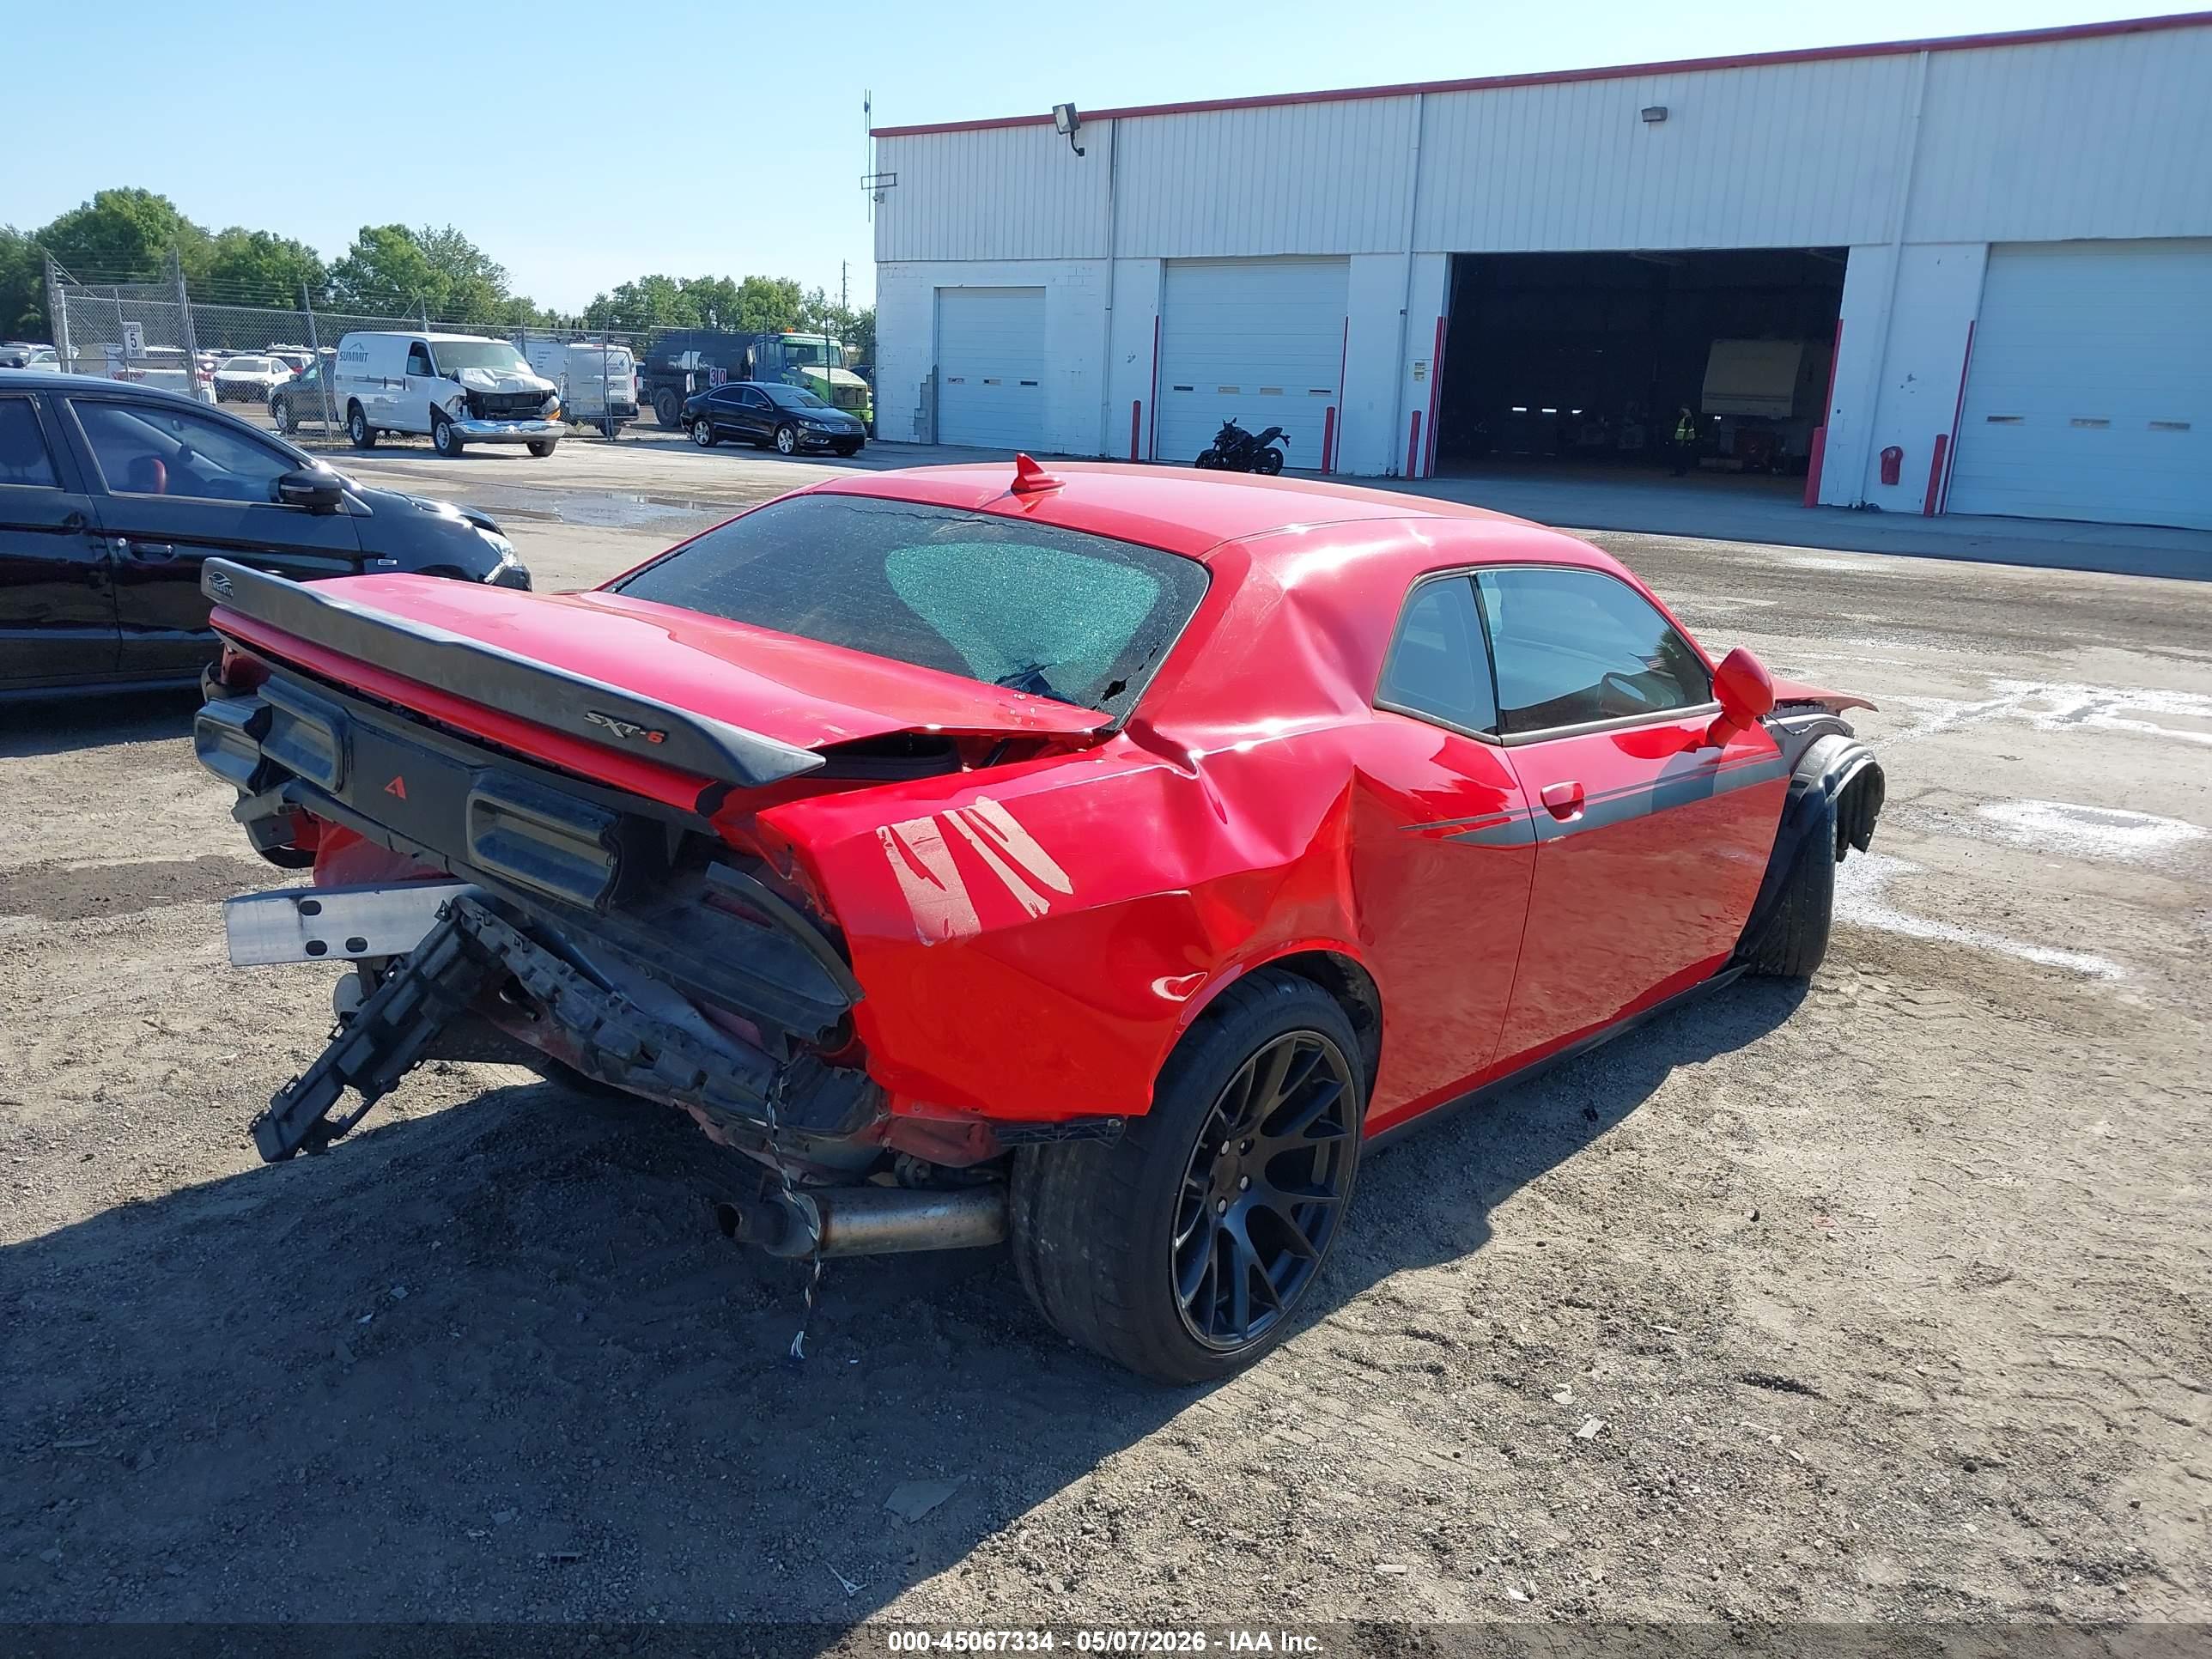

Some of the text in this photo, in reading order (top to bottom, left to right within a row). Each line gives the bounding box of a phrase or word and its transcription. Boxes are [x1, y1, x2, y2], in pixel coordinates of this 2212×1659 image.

[123, 325, 141, 333] SPEED
[130, 333, 137, 348] 5
[129, 349, 143, 357] LIMIT
[339, 351, 369, 362] SUMMIT
[584, 712, 665, 744] SXT-6
